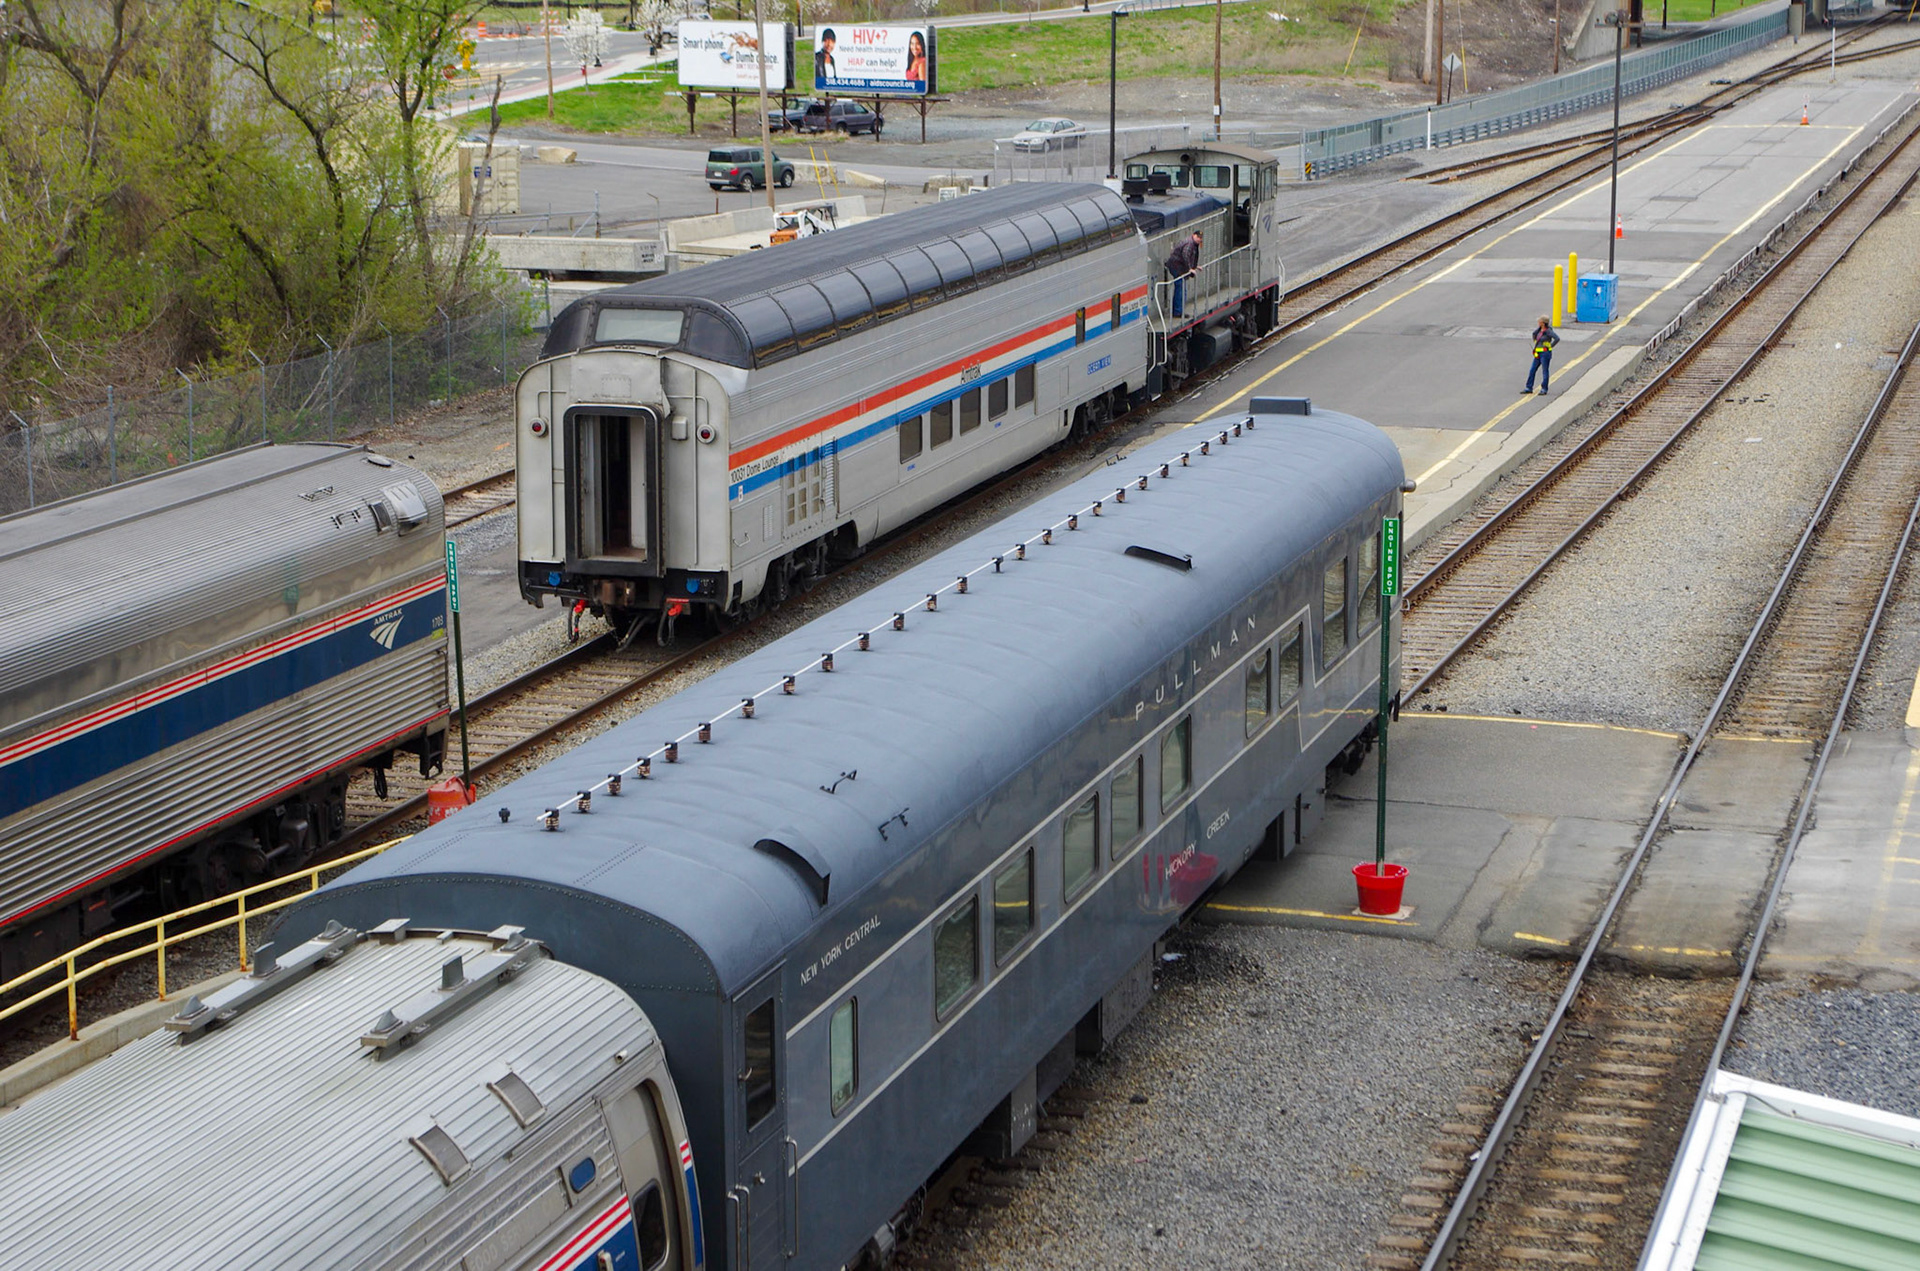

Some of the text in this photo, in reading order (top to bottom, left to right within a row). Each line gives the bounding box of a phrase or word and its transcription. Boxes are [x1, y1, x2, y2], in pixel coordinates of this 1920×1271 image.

[683, 37, 703, 49] Smart
[855, 45, 873, 53] health
[736, 50, 754, 63] Dumb
[880, 58, 897, 69] help!
[960, 360, 981, 384] Amtrak
[746, 463, 761, 477] Dome
[762, 455, 779, 470] Lounge
[374, 608, 403, 626] AMTRAK
[1135, 613, 1256, 721] PULLMAN
[1165, 808, 1230, 880] HICKORY CREEK
[800, 914, 881, 986] NEW YORK CENTRAL
